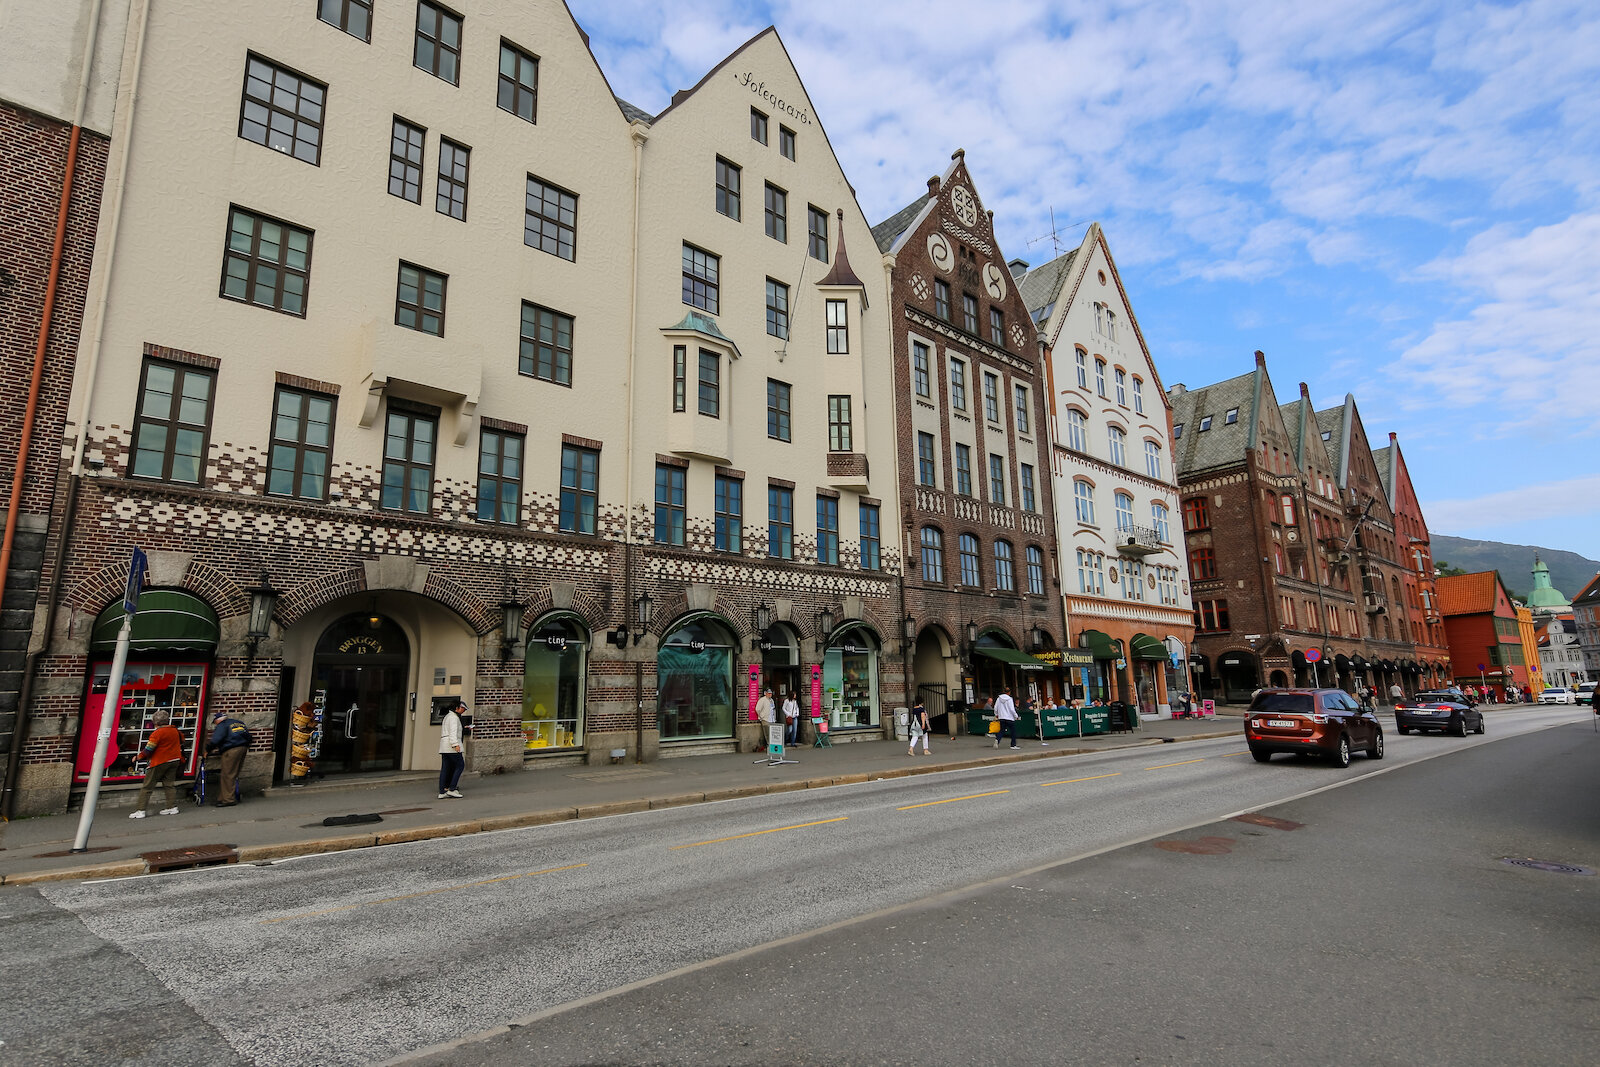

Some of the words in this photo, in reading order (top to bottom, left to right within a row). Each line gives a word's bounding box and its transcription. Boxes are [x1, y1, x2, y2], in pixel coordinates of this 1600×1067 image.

[338, 635, 384, 654] BRYGGEN
[548, 635, 565, 647] ting
[691, 640, 705, 650] ting
[358, 646, 367, 654] 13
[1063, 652, 1093, 663] Restaurant
